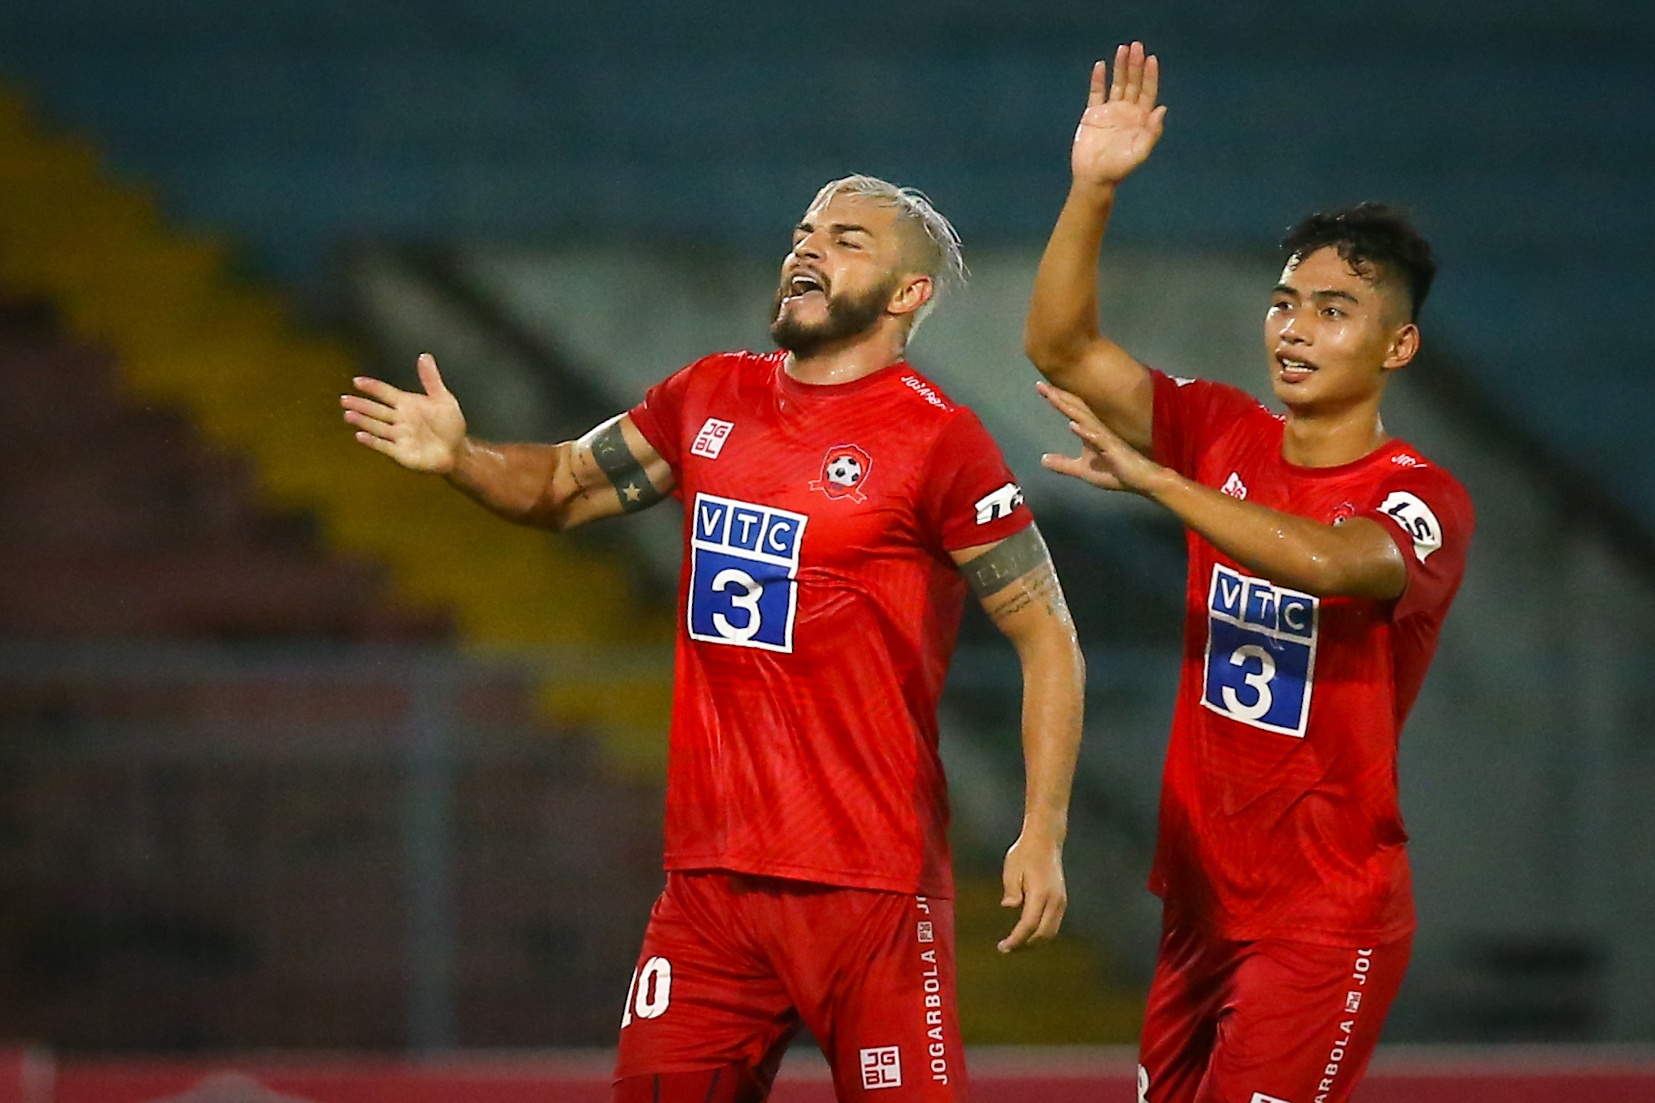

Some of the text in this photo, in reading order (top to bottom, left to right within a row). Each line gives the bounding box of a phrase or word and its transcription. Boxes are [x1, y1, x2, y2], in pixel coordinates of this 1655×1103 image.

[700, 505, 791, 552] VTC
[711, 568, 764, 643] 3
[1220, 578, 1306, 631] VTC
[1221, 643, 1277, 721] 3
[920, 949, 948, 1085] JOGARBOLA
[863, 1051, 896, 1069] JG
[865, 1069, 898, 1086] BL
